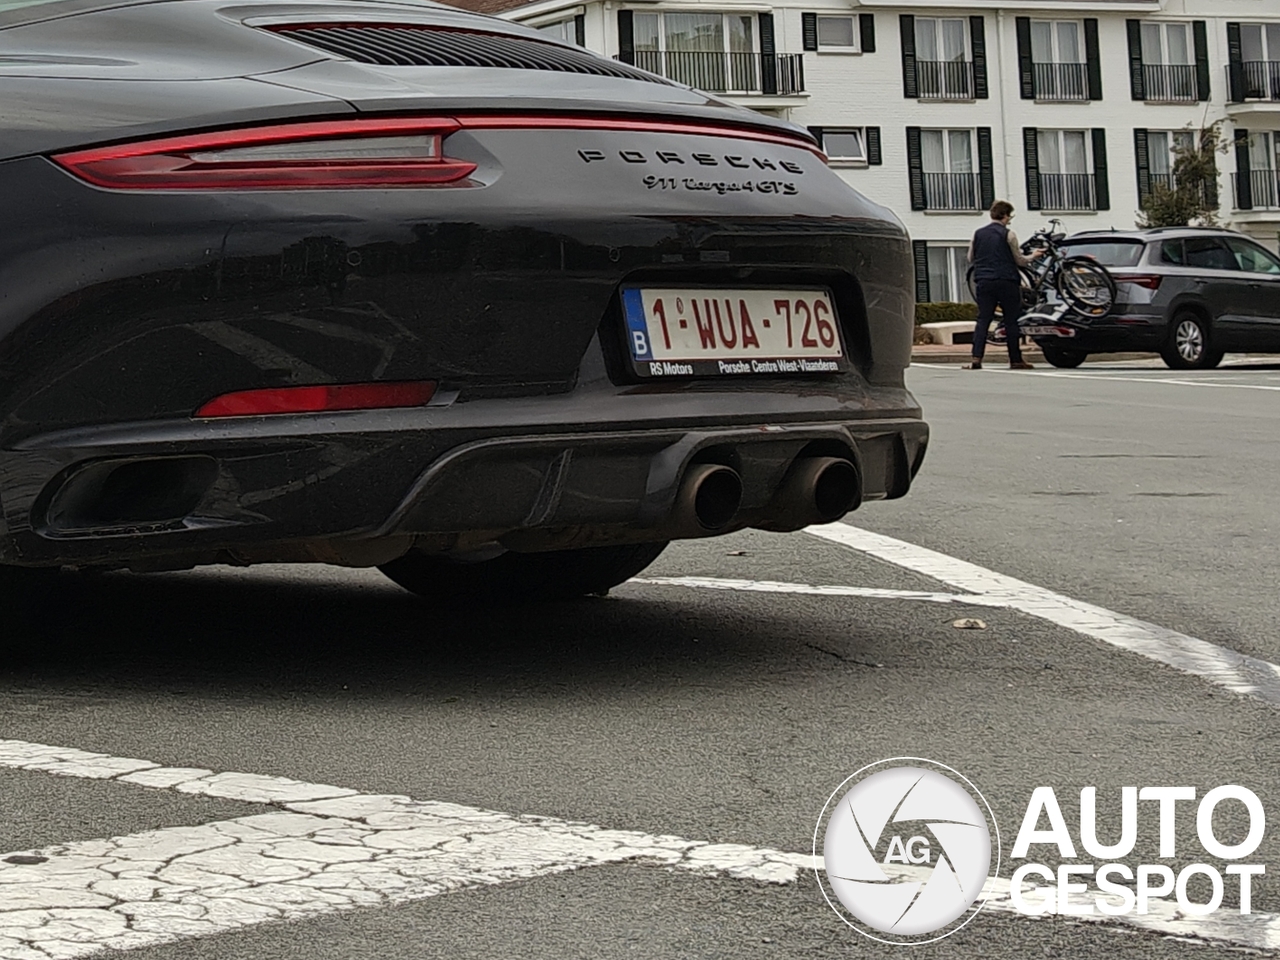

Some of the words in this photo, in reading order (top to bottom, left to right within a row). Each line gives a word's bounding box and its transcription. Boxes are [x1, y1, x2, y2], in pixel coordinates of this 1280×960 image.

[577, 149, 804, 175] PORSCHE
[642, 175, 677, 190] 911
[756, 180, 799, 196] GTS
[652, 297, 835, 350] 1-WUA-726
[632, 331, 648, 355] B
[649, 361, 663, 376] RS
[663, 361, 694, 375] Motors
[718, 360, 751, 374] Porsche
[751, 360, 778, 373] Centre
